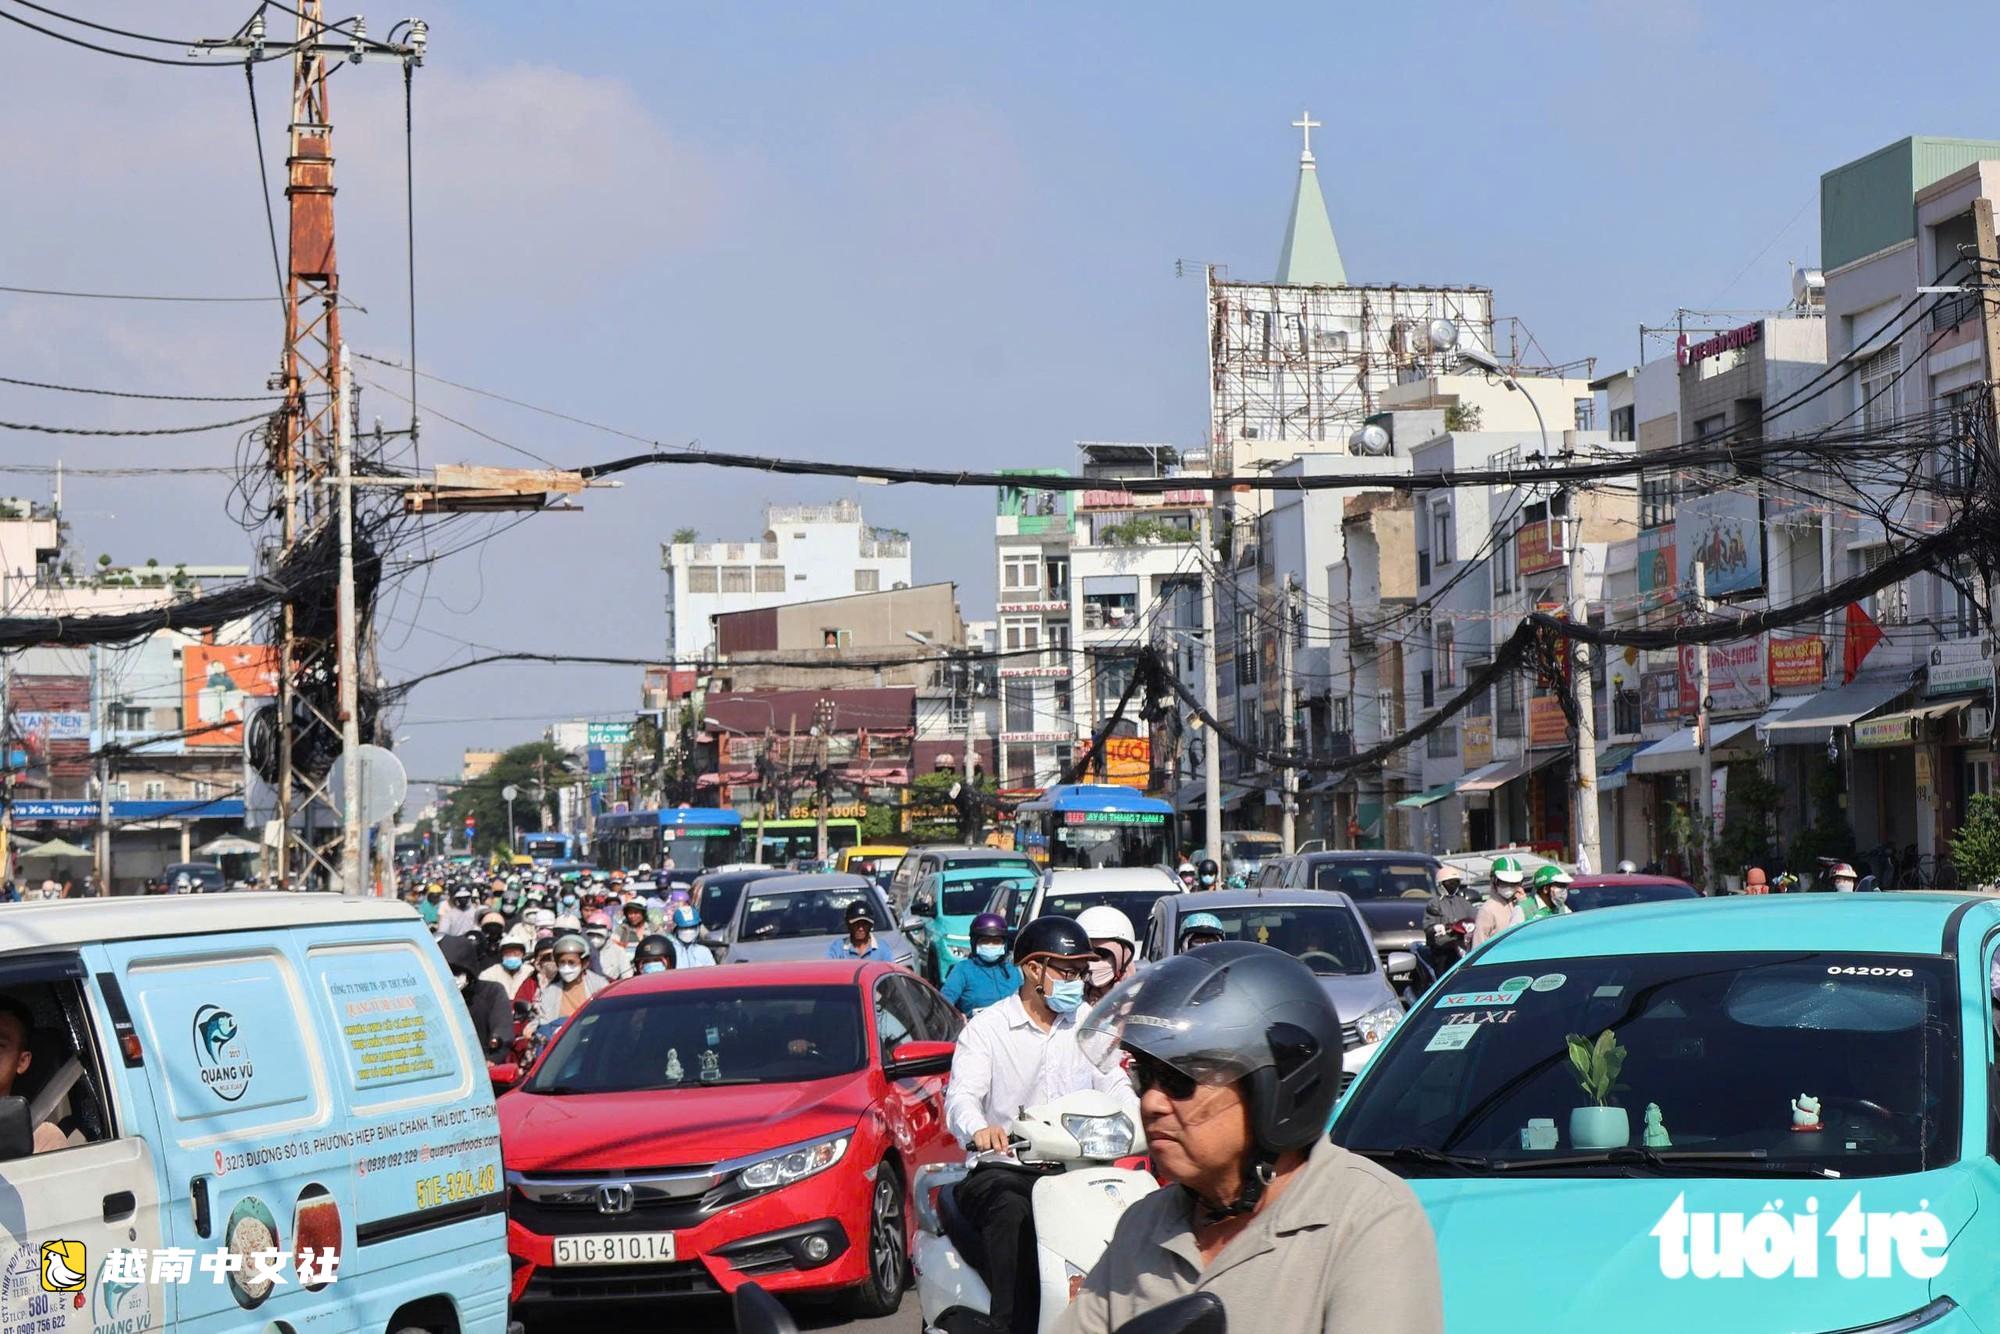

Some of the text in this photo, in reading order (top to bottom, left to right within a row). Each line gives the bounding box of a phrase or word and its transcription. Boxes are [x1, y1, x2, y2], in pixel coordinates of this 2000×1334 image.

[28, 805, 45, 815] Xe
[52, 804, 81, 816] Thay
[83, 803, 114, 815] Nht
[1446, 994, 1513, 1004] XE TAXI
[1447, 1009, 1516, 1026] TAXI
[201, 1061, 253, 1085] QUANG VŨ
[225, 1154, 244, 1171] 32/3
[246, 1146, 283, 1167] ĐƯỜNG
[367, 1149, 418, 1172] 0938 092 329
[416, 1164, 496, 1210] 51E-324.48
[28, 1293, 49, 1318] 580
[17, 1321, 36, 1334] 0909
[36, 1319, 50, 1332] 756
[52, 1314, 66, 1329] 622
[136, 1310, 151, 1330] VŨ
